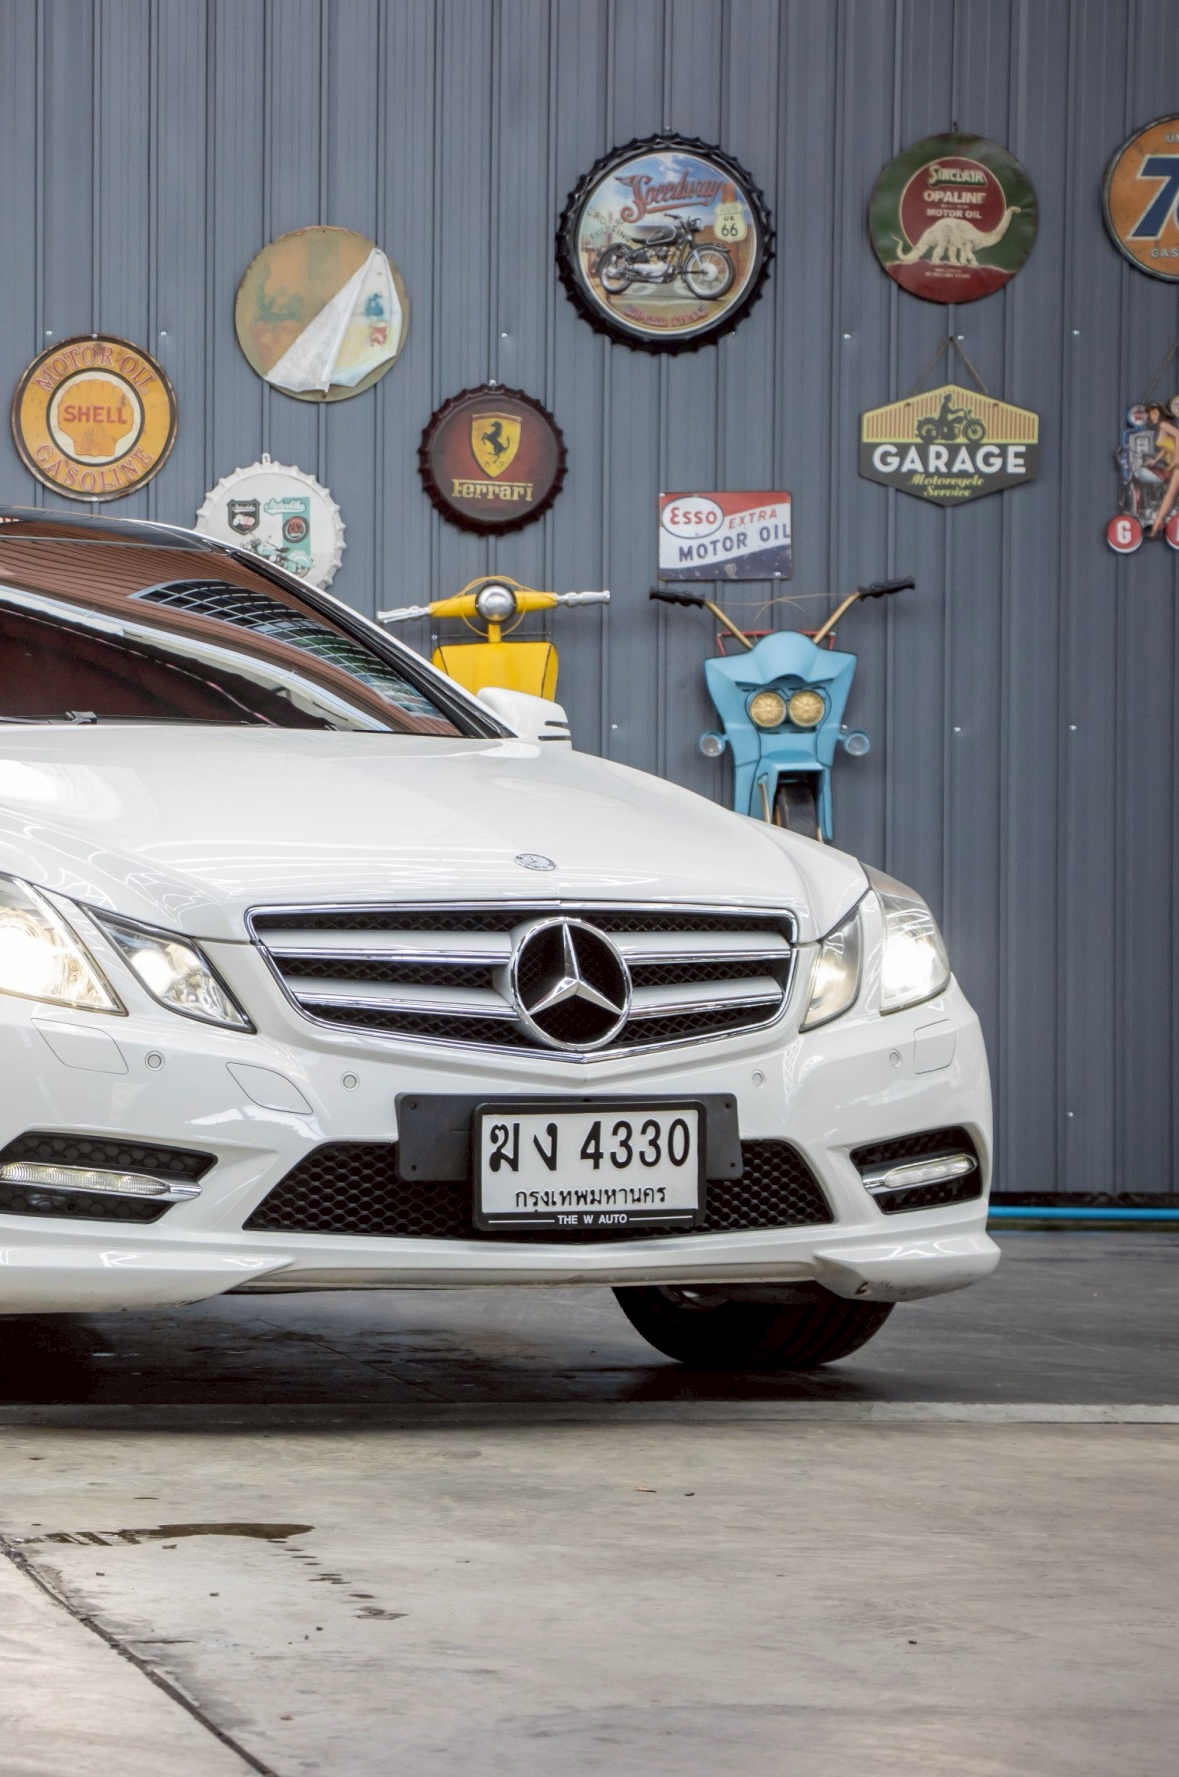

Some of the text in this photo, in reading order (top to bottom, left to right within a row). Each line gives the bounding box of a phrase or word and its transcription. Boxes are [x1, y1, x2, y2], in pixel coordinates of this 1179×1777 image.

[614, 167, 721, 224] Speedway
[923, 190, 987, 204] OPALINE
[1127, 154, 1179, 240] 7
[926, 208, 983, 219] MOTOR OIL
[721, 223, 738, 237] 66
[34, 344, 157, 396] MOTOR OIL
[63, 404, 128, 425] SHELL
[35, 444, 154, 491] GASOLINE
[873, 444, 1027, 473] GARAGE
[451, 478, 534, 502] Ferrari
[908, 474, 984, 487] Motorcycle
[923, 486, 972, 498] Service
[728, 507, 777, 530] EXTRA
[678, 523, 790, 562] MOTOR OIL
[580, 1118, 690, 1170] 4330
[515, 1186, 667, 1213] กรุงเทพมหานคร
[558, 1213, 628, 1225] THE W AUTO
